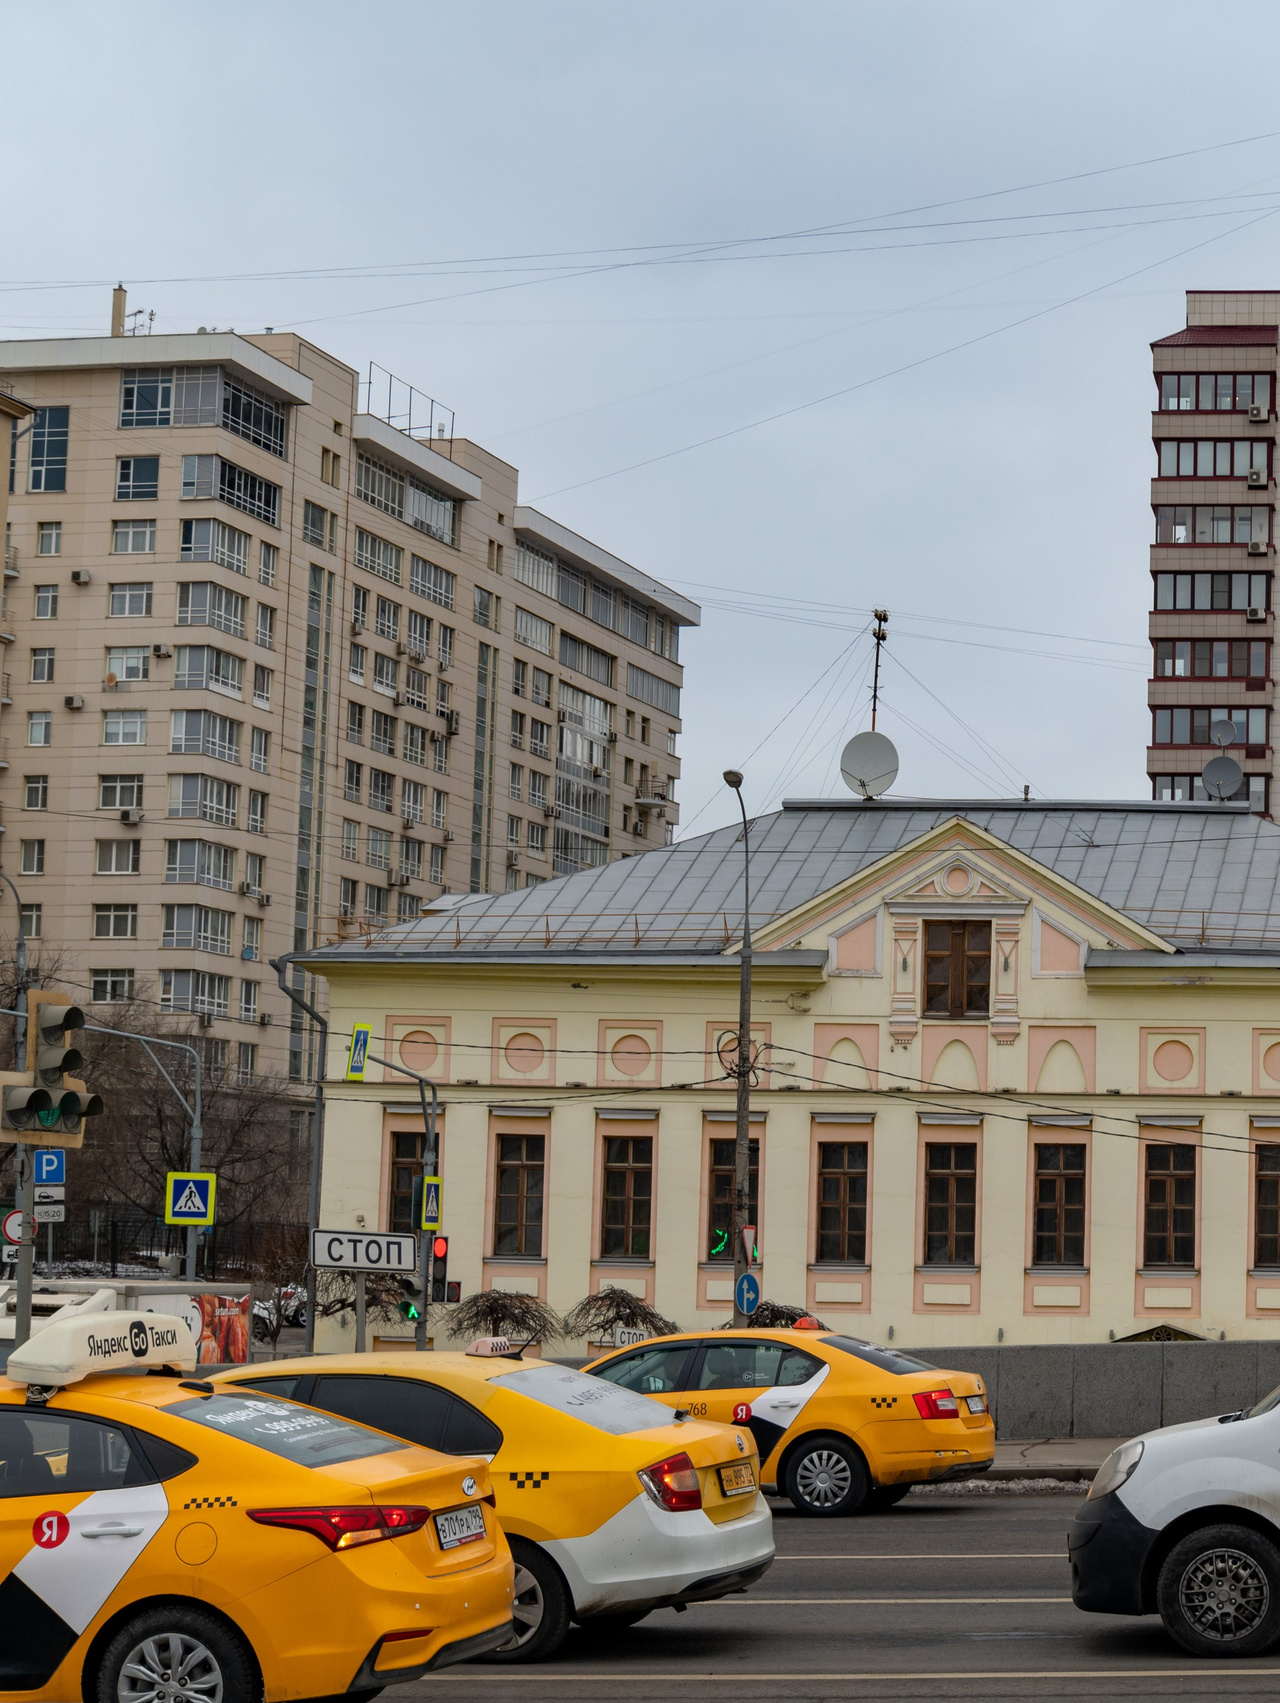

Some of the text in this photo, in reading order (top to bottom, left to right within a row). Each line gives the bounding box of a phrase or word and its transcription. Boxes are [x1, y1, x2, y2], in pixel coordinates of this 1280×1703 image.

[42, 1154, 58, 1180] P
[327, 1237, 402, 1265] СТОП
[87, 1334, 129, 1358] Яндекс
[148, 1326, 178, 1348] Такси
[687, 1402, 707, 1416] 768
[737, 1405, 747, 1419] Я
[40, 1515, 58, 1543] Я
